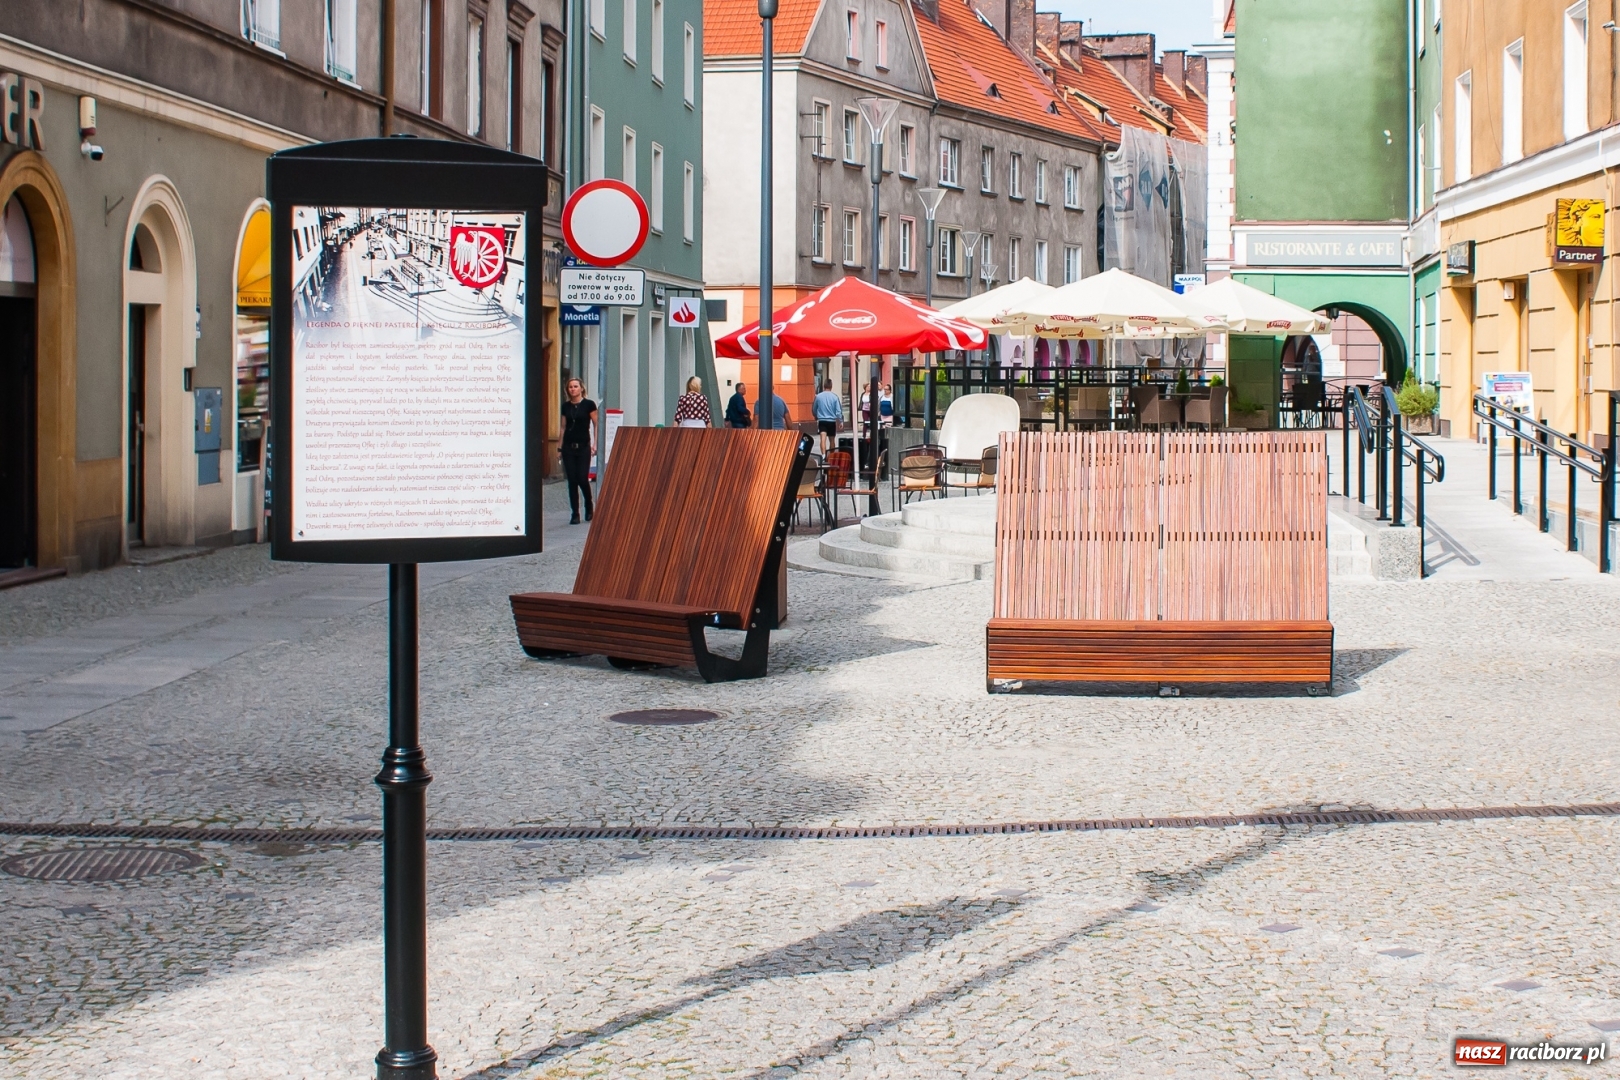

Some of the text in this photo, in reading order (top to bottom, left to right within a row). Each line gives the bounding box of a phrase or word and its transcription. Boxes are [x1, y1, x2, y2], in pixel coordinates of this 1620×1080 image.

[1254, 242, 1394, 256] RISTORANTE & CAFE
[1558, 250, 1598, 260] Partner
[596, 272, 626, 283] dotyczy
